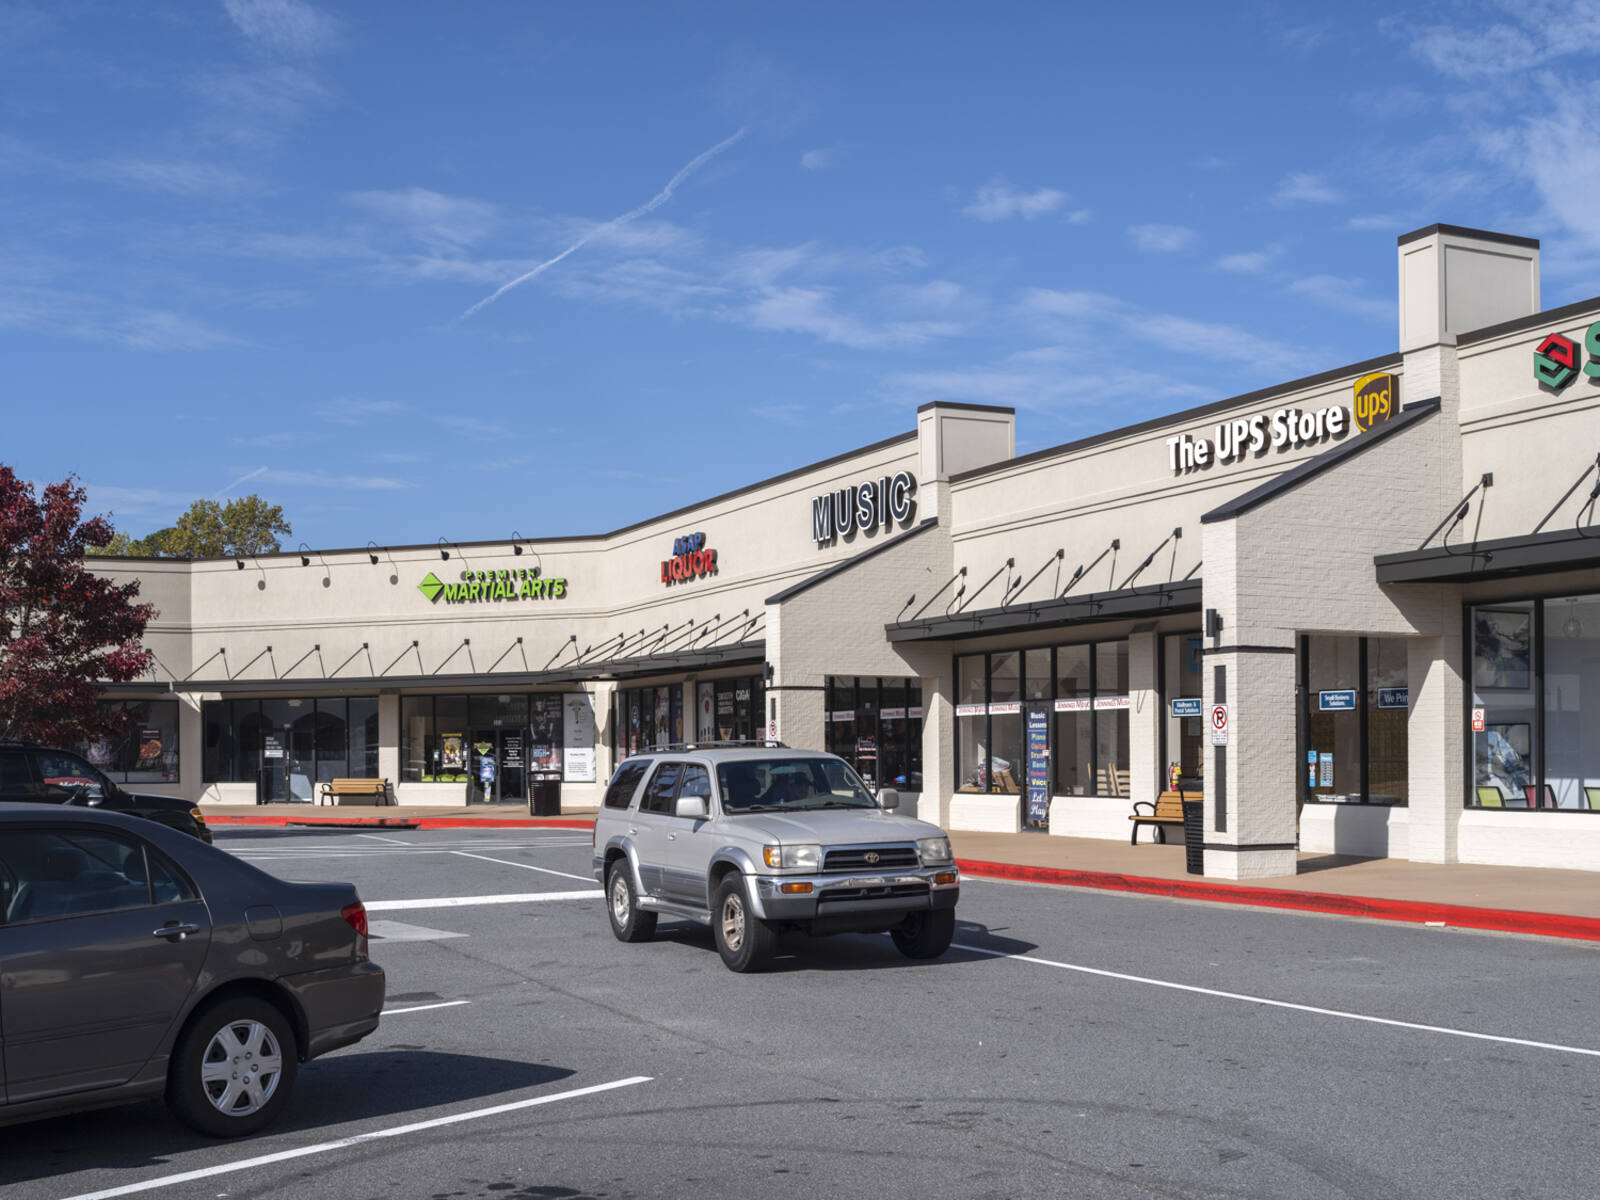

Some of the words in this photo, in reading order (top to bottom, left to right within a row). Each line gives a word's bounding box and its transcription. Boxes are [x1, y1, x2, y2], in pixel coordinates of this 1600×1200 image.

[1356, 389, 1389, 426] ups
[1166, 433, 1208, 471] The
[1214, 414, 1265, 460] UPS
[1271, 404, 1344, 448] Store
[811, 470, 912, 543] MUSIC
[672, 531, 703, 556] ASAP
[465, 567, 536, 580] PREMIER
[660, 548, 715, 584] LIQUOR
[443, 580, 516, 601] MARTIAL
[519, 577, 565, 598] ARTS
[735, 688, 751, 701] CIGA
